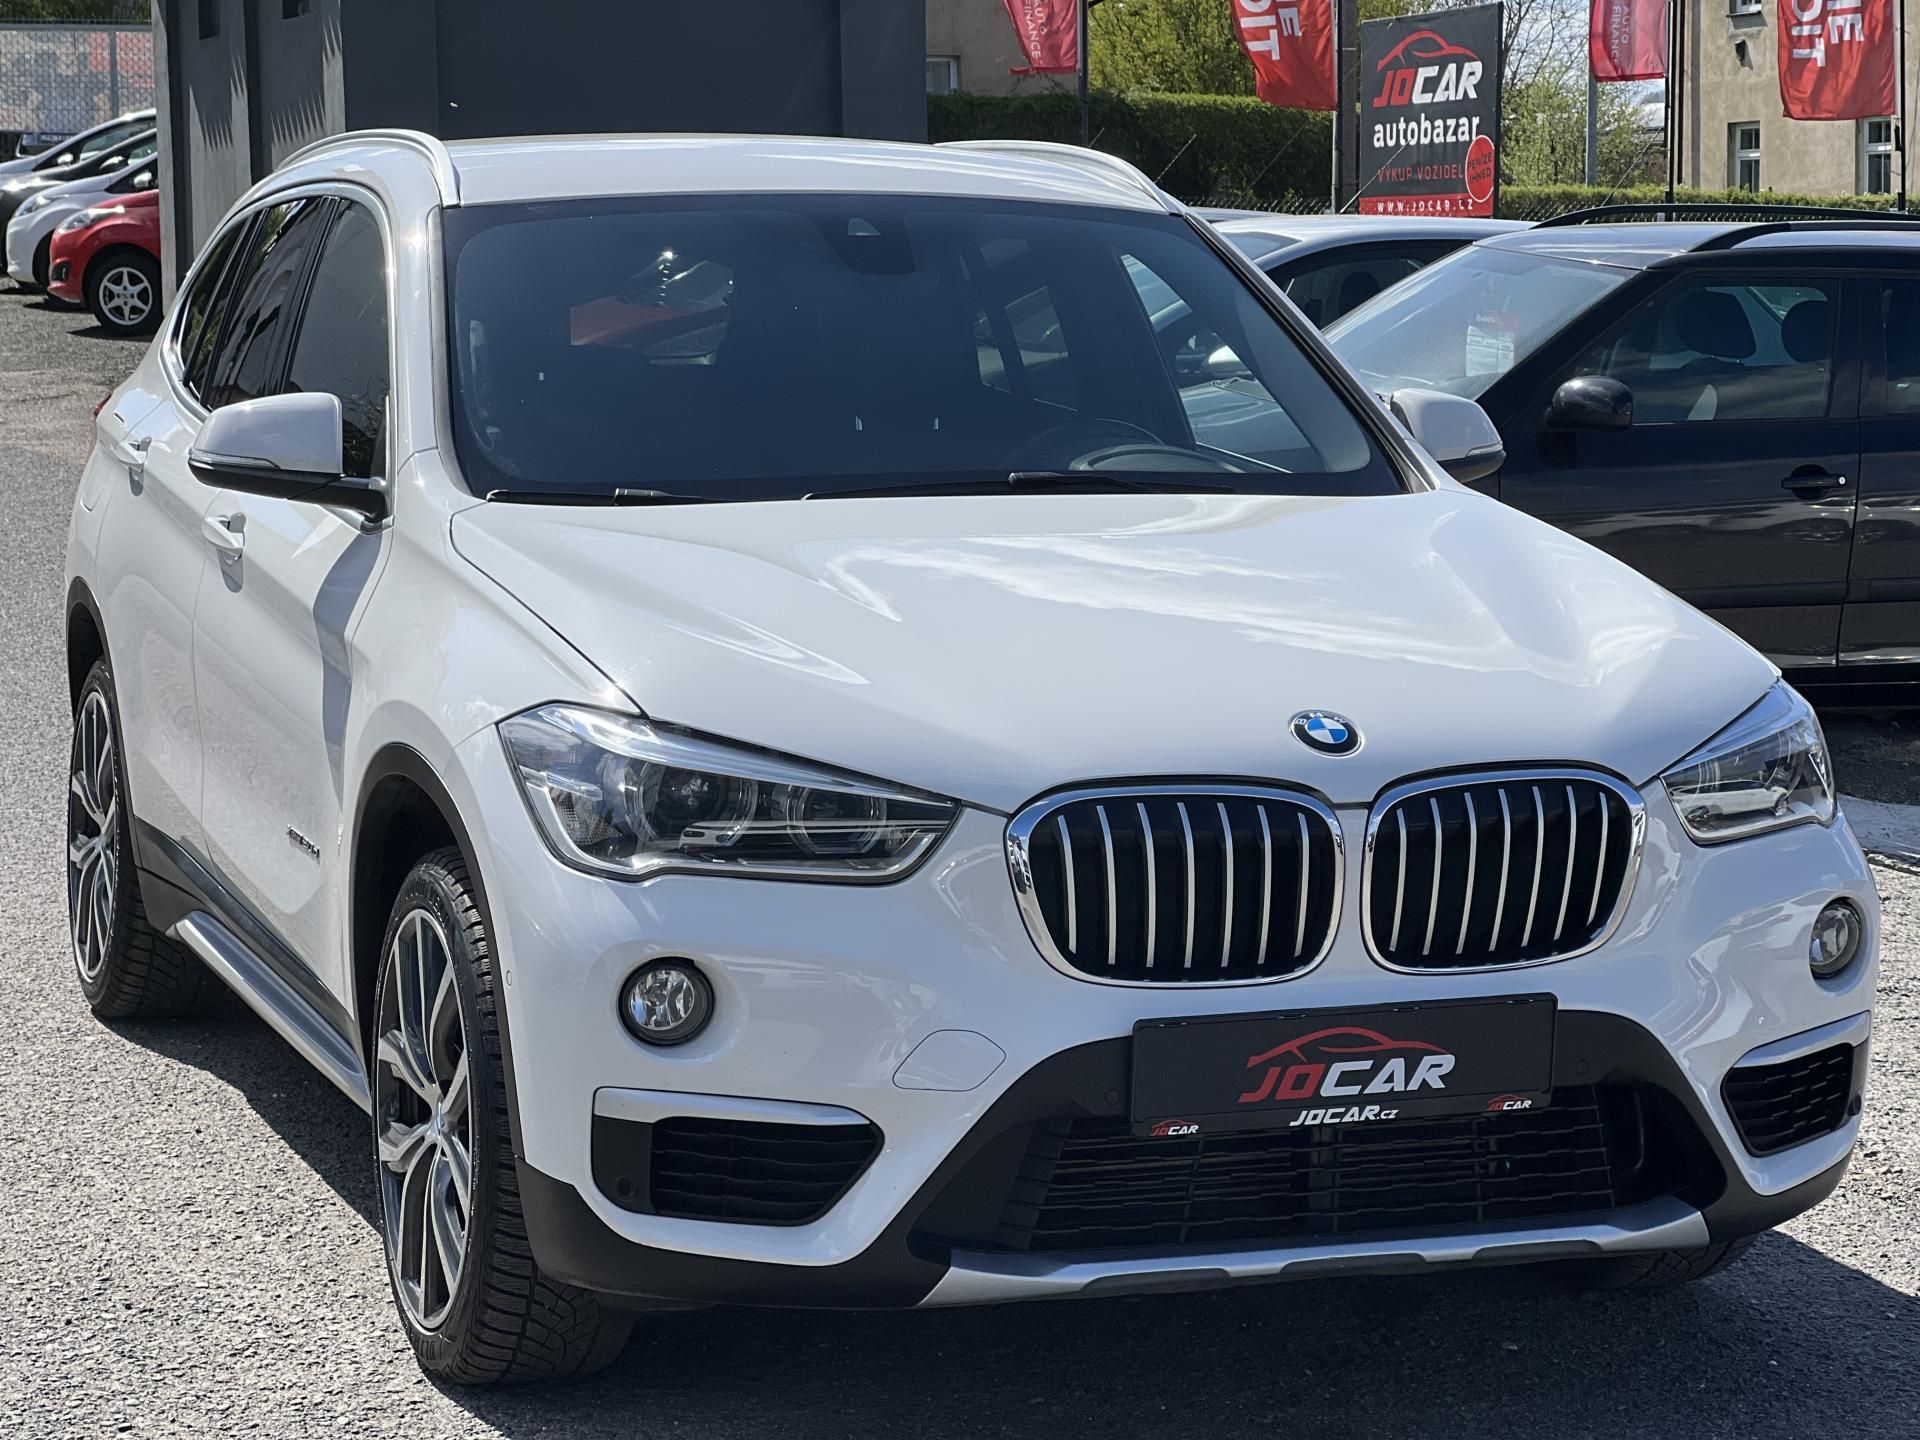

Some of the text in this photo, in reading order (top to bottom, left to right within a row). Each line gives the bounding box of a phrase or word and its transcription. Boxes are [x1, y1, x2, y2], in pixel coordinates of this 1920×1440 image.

[1622, 6, 1630, 44] AUTO
[1372, 61, 1483, 108] JOCAR
[1373, 113, 1480, 148] autobazar
[1377, 164, 1464, 182] VÝKUP VOZIDEL
[1470, 166, 1492, 184] IHNED
[1238, 1054, 1456, 1103] JOCAR
[1487, 1099, 1532, 1112] JOCAR
[1151, 1124, 1199, 1137] JOCAR
